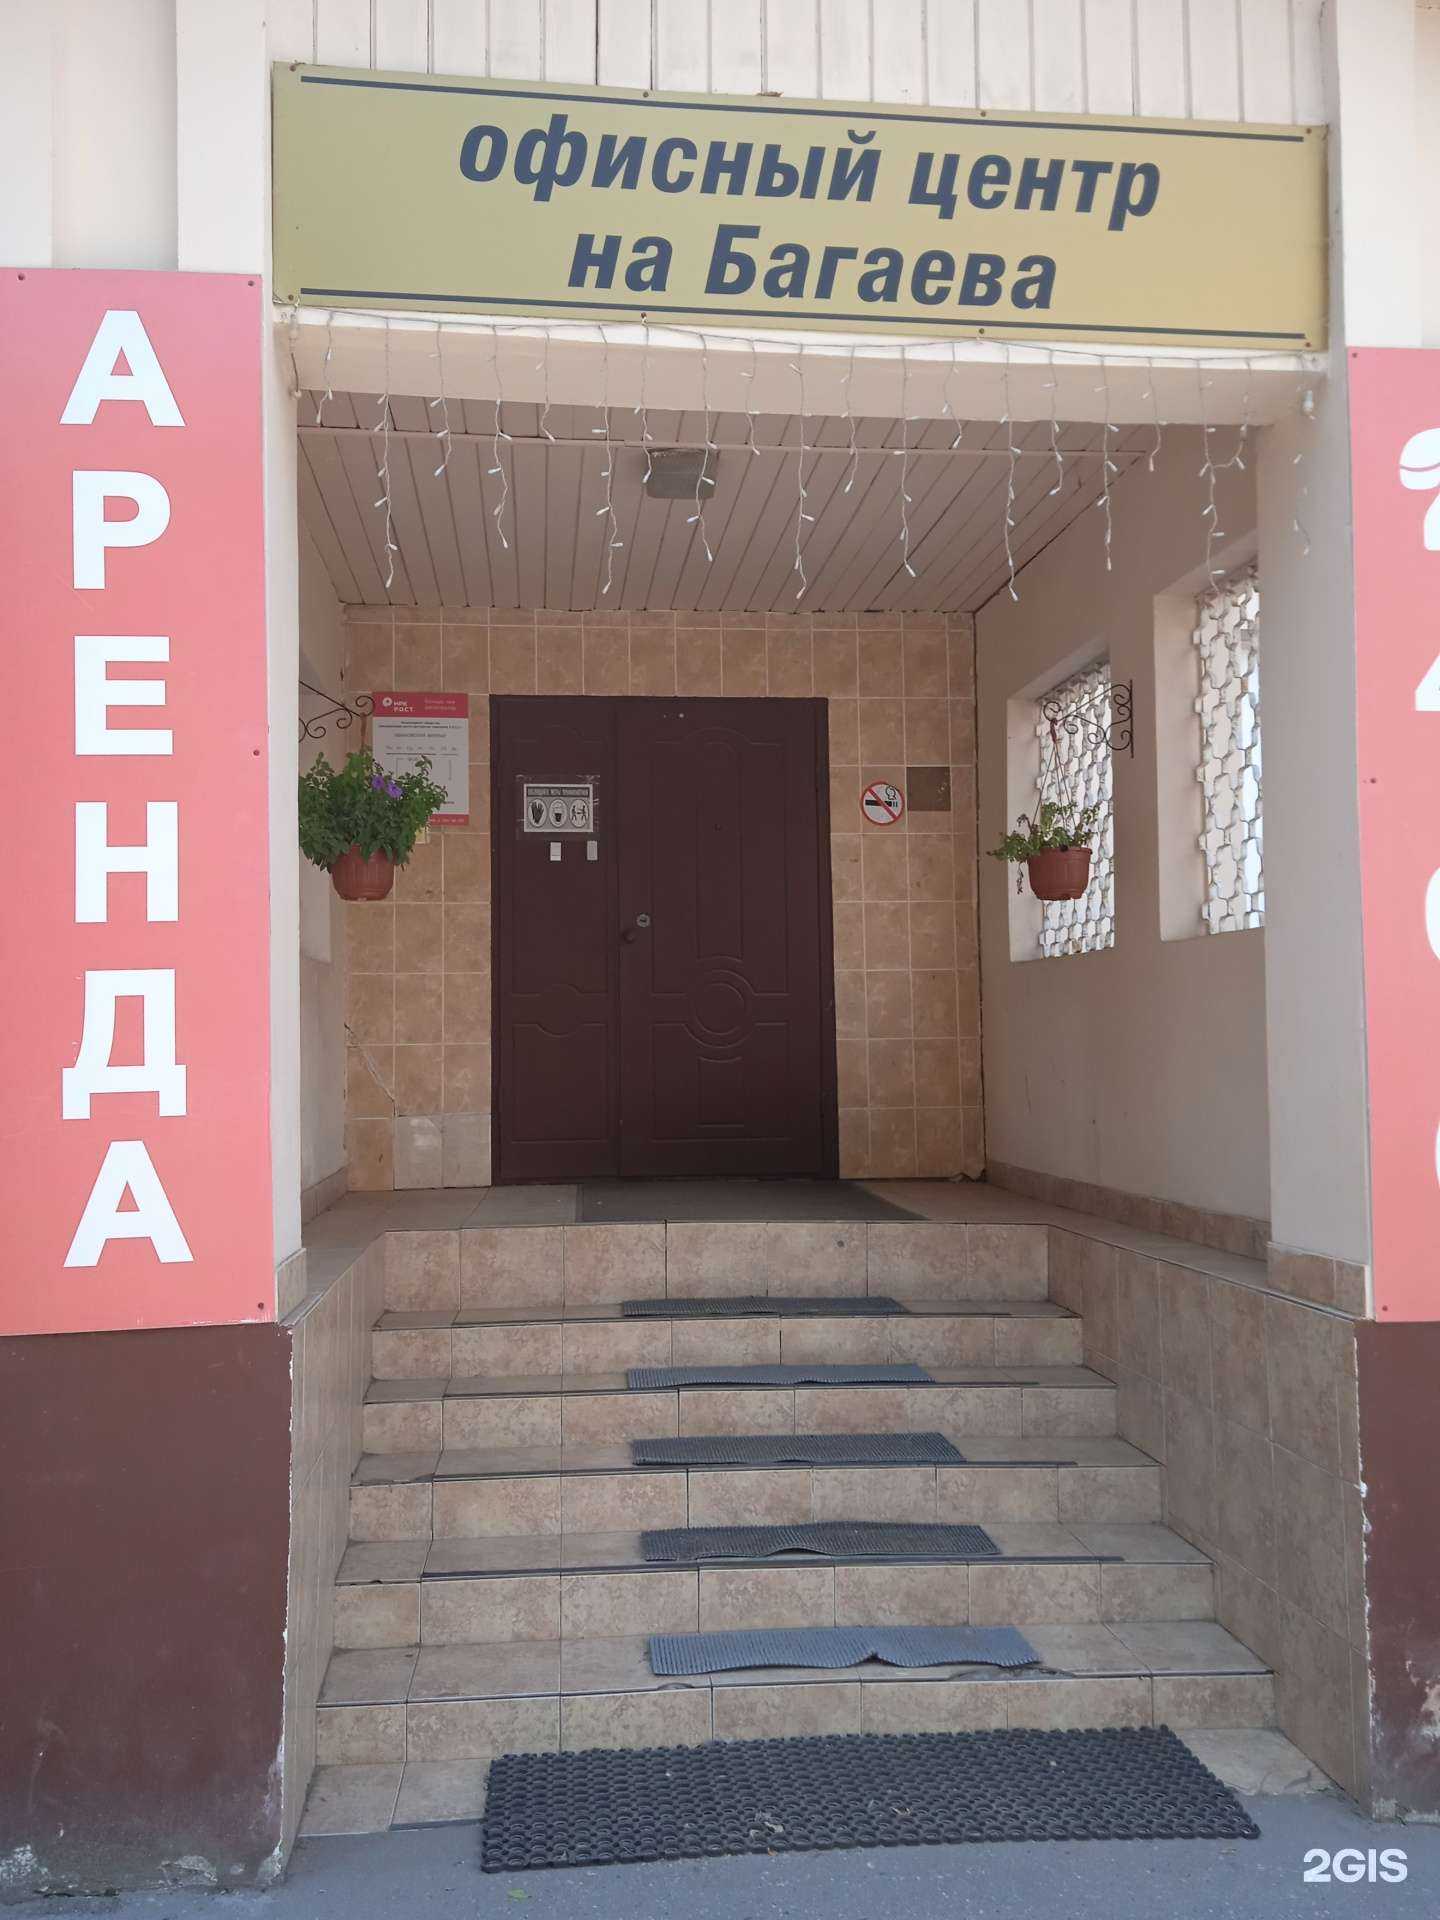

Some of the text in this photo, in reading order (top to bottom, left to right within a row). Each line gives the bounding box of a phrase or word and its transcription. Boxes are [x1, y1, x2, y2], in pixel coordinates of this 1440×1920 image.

[459, 113, 1160, 232] офисный центр
[567, 223, 1056, 309] на Багаева
[59, 308, 194, 1268] АРЕНДА
